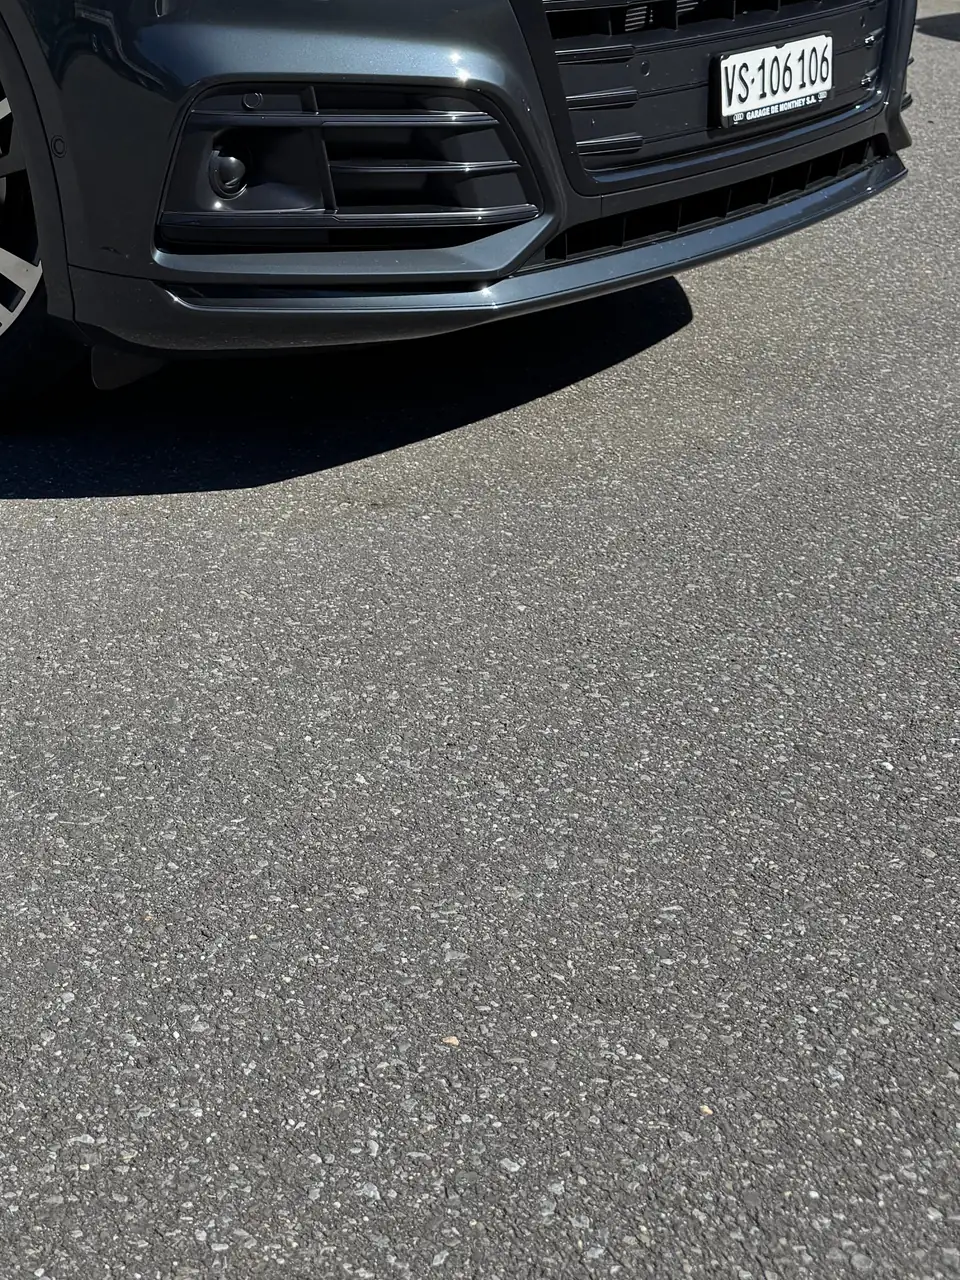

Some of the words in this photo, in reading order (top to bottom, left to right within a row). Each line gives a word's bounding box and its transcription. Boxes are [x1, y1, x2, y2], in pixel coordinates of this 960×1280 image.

[746, 106, 771, 120] GARAGE
[771, 104, 779, 114] DE
[779, 98, 806, 112] MONTHEY
